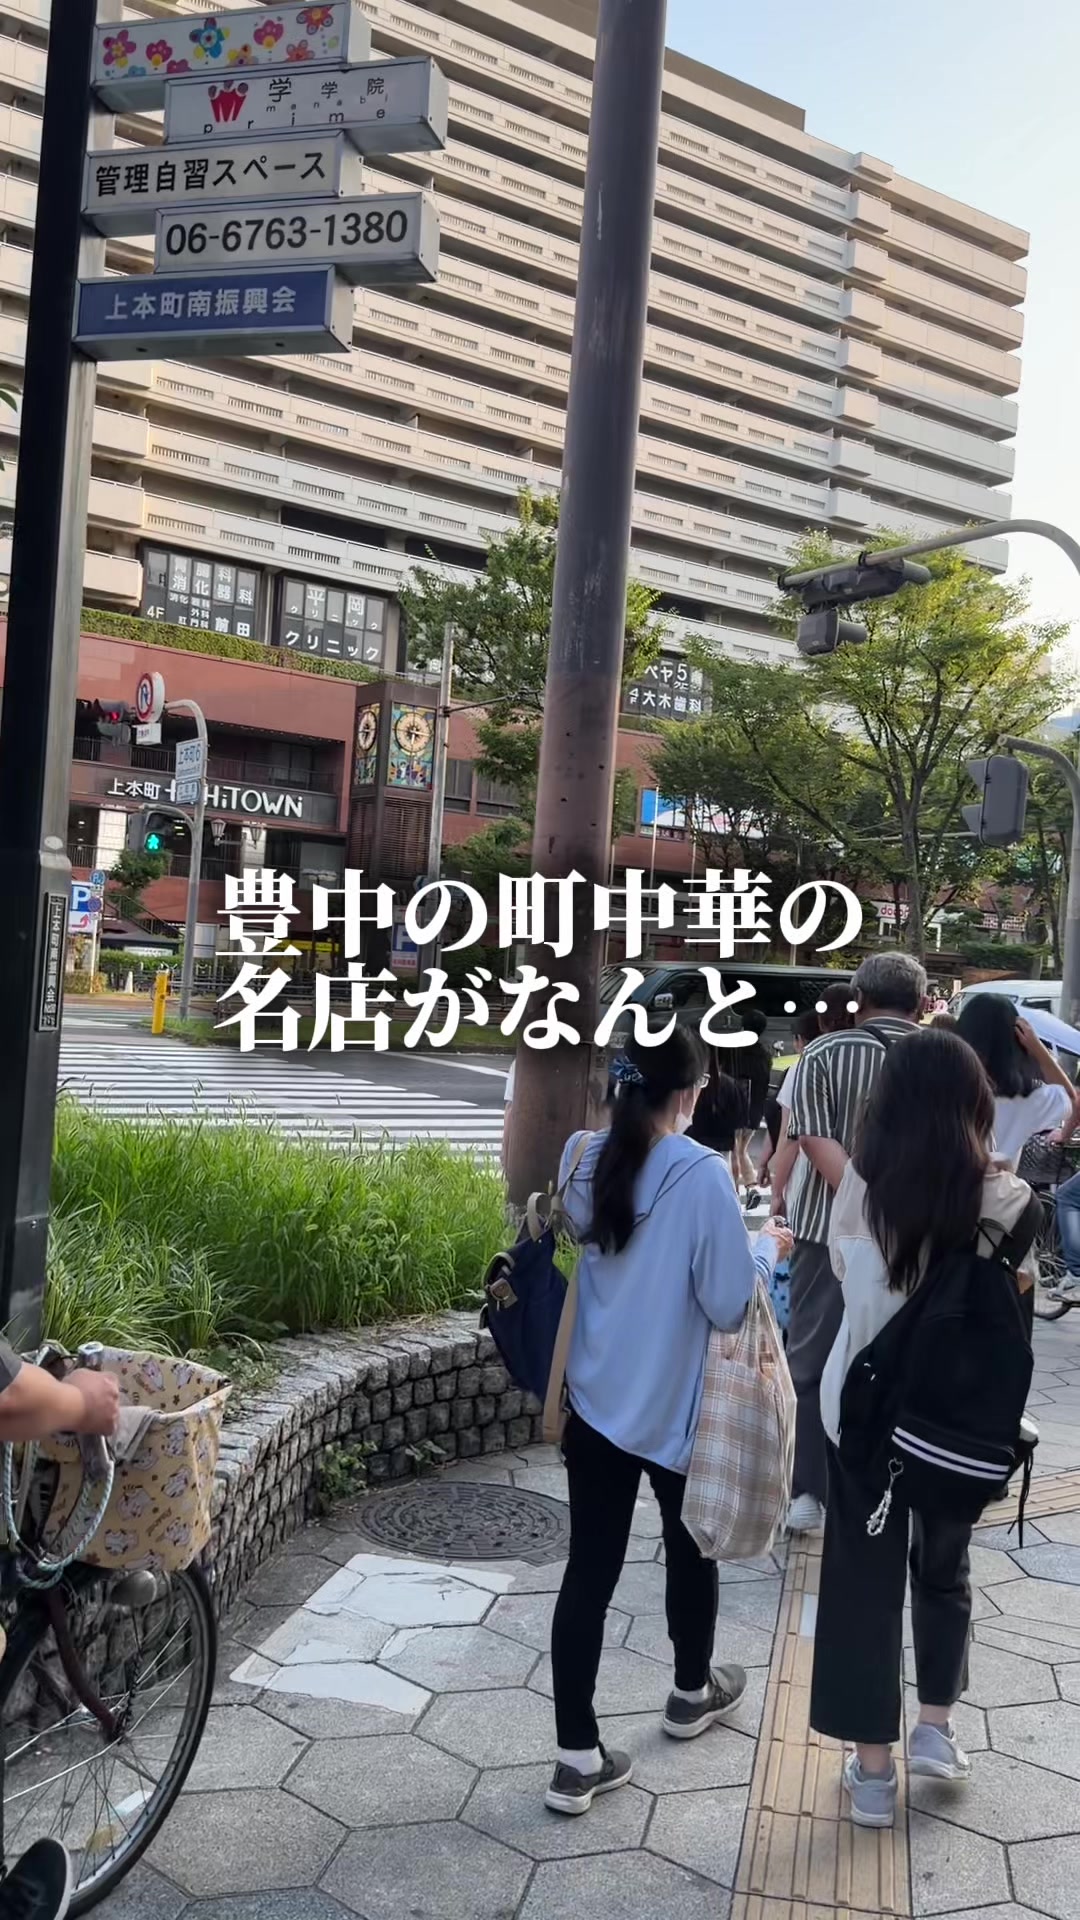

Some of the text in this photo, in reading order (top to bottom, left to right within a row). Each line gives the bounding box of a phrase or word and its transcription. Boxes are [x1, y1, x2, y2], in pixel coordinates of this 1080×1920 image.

[95, 152, 326, 198] 管理自習スペース
[165, 209, 408, 256] 06-6763-1380
[105, 285, 297, 321] 上本町南振興会
[172, 573, 254, 606] 消化器科
[307, 588, 364, 615] 平岡
[147, 605, 165, 619] 4F
[215, 616, 251, 638] 前田
[285, 630, 379, 661] クリニック
[107, 777, 161, 801] 上本町
